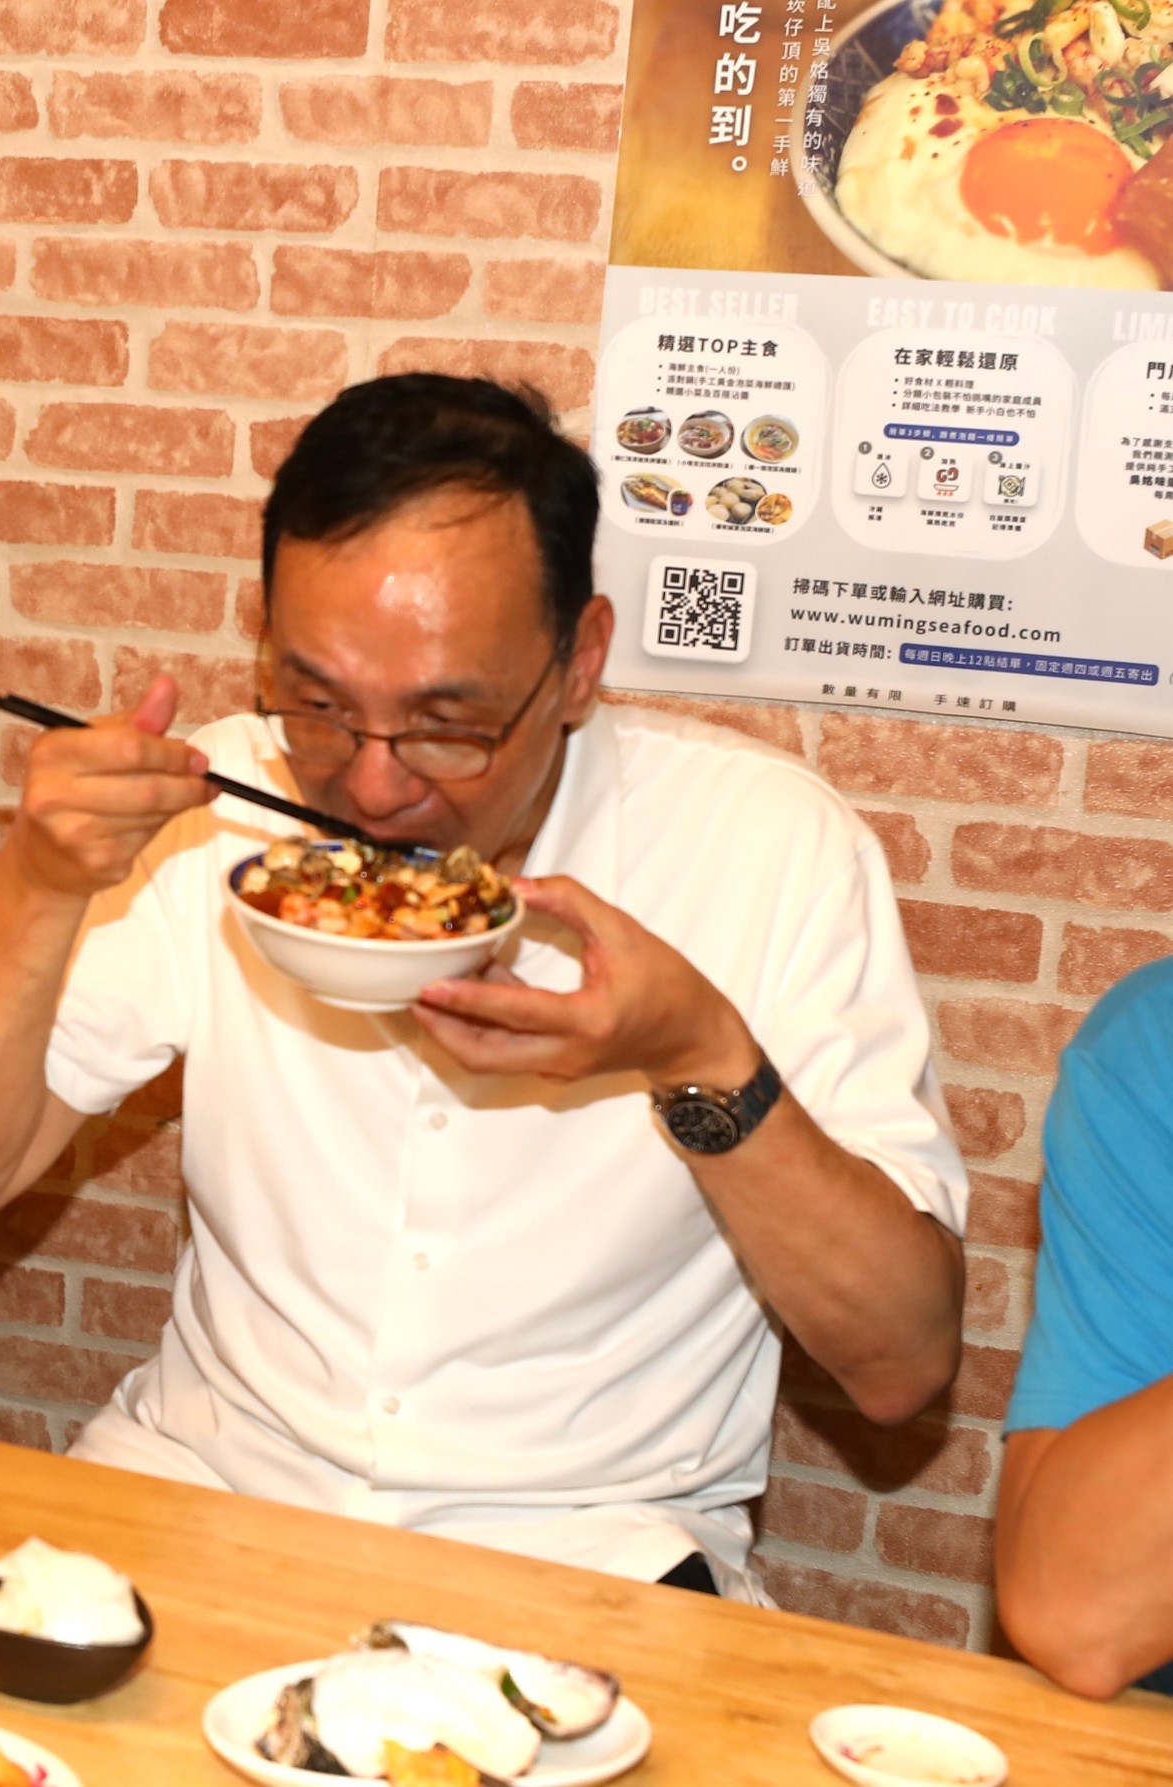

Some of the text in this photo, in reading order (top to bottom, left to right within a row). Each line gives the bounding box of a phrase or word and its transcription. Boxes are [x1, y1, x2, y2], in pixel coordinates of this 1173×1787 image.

[708, 1, 762, 172] 吃的到。
[638, 286, 799, 322] BEST SELLER
[866, 297, 1058, 335] EASY TO COOK
[658, 334, 779, 357] 精選TOP主食
[893, 347, 1019, 371] 在家輕鬆還原
[1146, 361, 1173, 380] 門
[789, 606, 1062, 643] www.wumingseafood.com
[821, 683, 1017, 713] 數量有限 手速訂購
